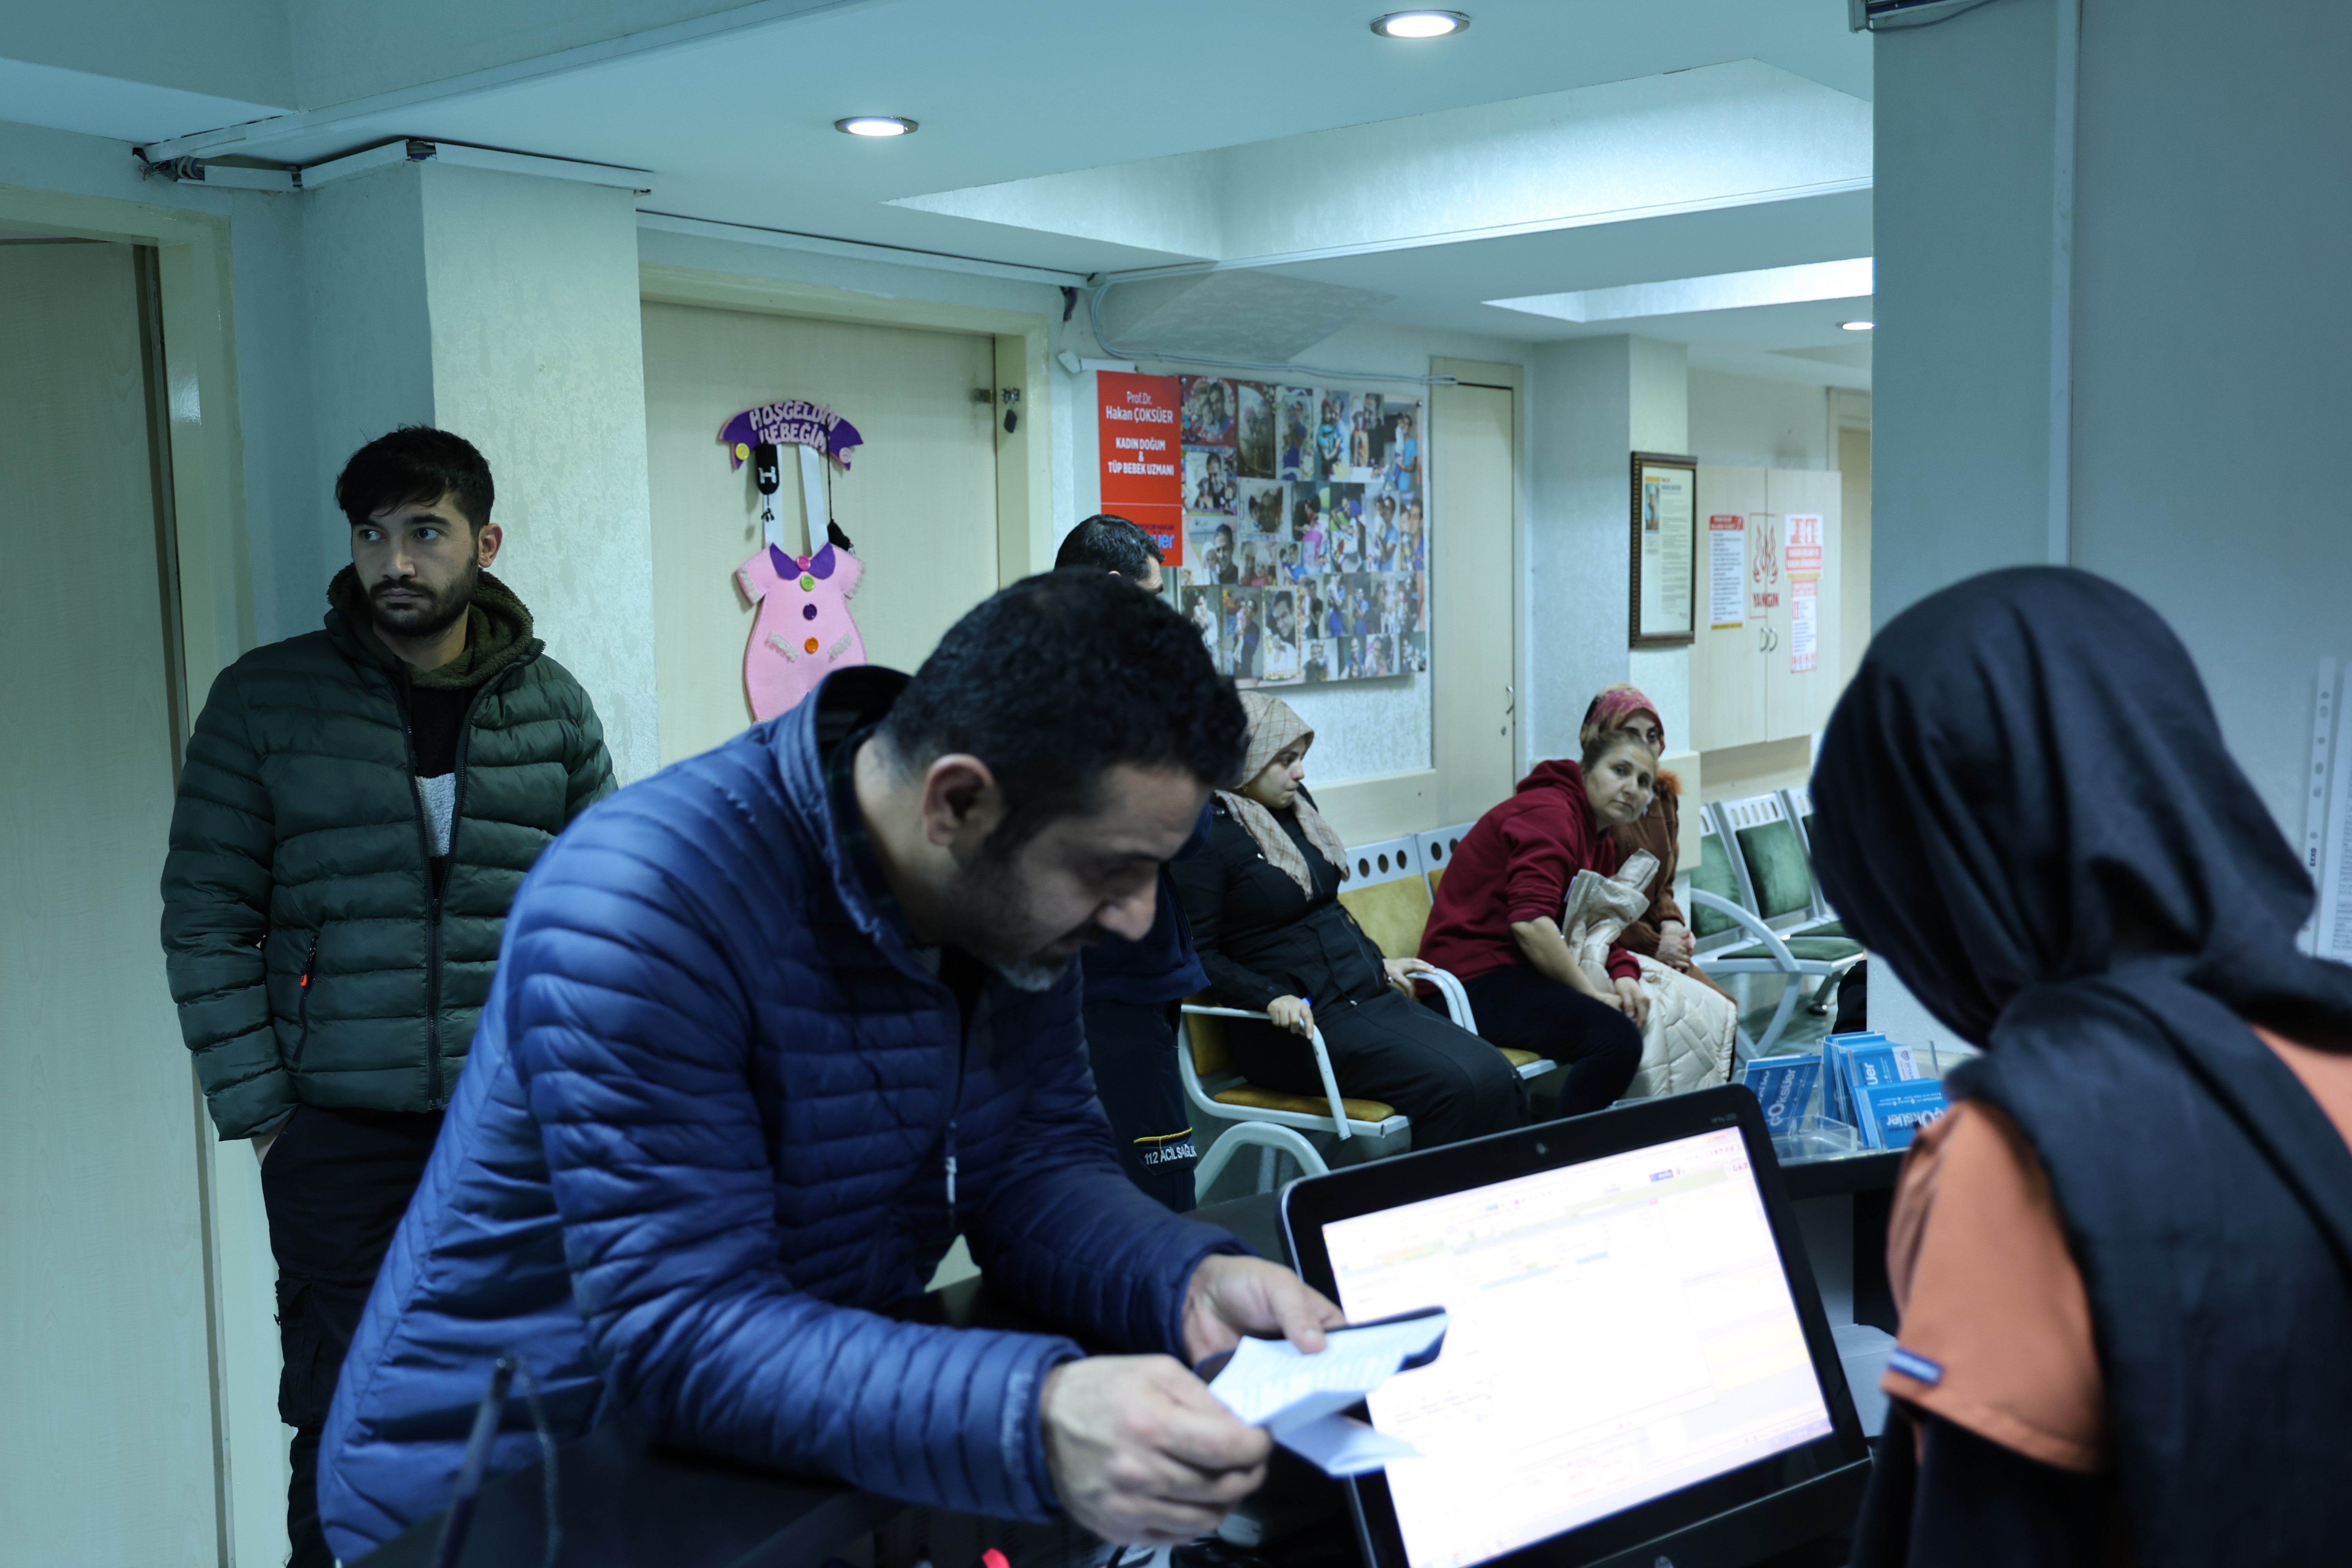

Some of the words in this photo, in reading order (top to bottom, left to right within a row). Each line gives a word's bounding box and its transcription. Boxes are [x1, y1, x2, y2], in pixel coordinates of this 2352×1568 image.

[749, 400, 841, 431] HOŞGELDİN
[1105, 405, 1132, 421] Hakan
[1134, 407, 1173, 423] ÇOKSÜER
[758, 421, 827, 453] BEBEĞİM
[1116, 437, 1138, 449] KADIN
[1140, 437, 1166, 451] DOĞUM
[1138, 451, 1145, 462] &
[1108, 459, 1122, 474] TÜP
[1123, 462, 1146, 475] BEBEK
[1147, 463, 1174, 476] UZMANI
[1145, 1151, 1159, 1165] 112
[1160, 1147, 1178, 1162] ACİL
[1176, 1143, 1197, 1159] SAĞLIK
